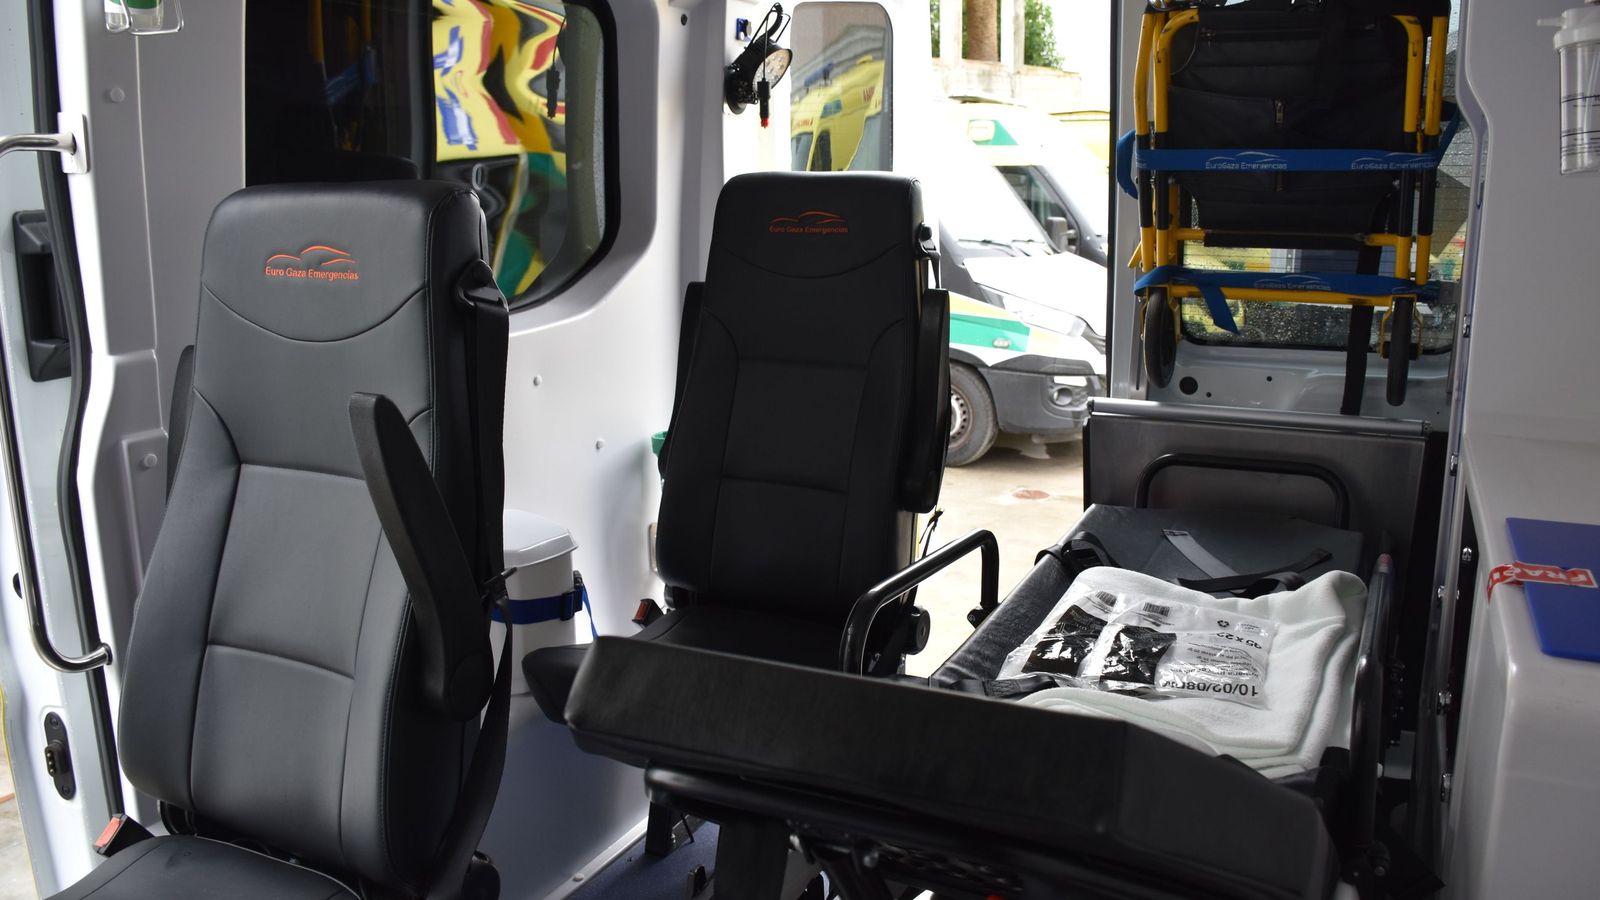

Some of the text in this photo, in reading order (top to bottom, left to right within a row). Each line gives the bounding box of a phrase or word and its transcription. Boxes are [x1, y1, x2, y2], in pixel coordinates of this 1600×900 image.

[769, 225, 848, 234] Euro Gaza Emergencias
[265, 266, 359, 282] Euro Gaza Emergencias
